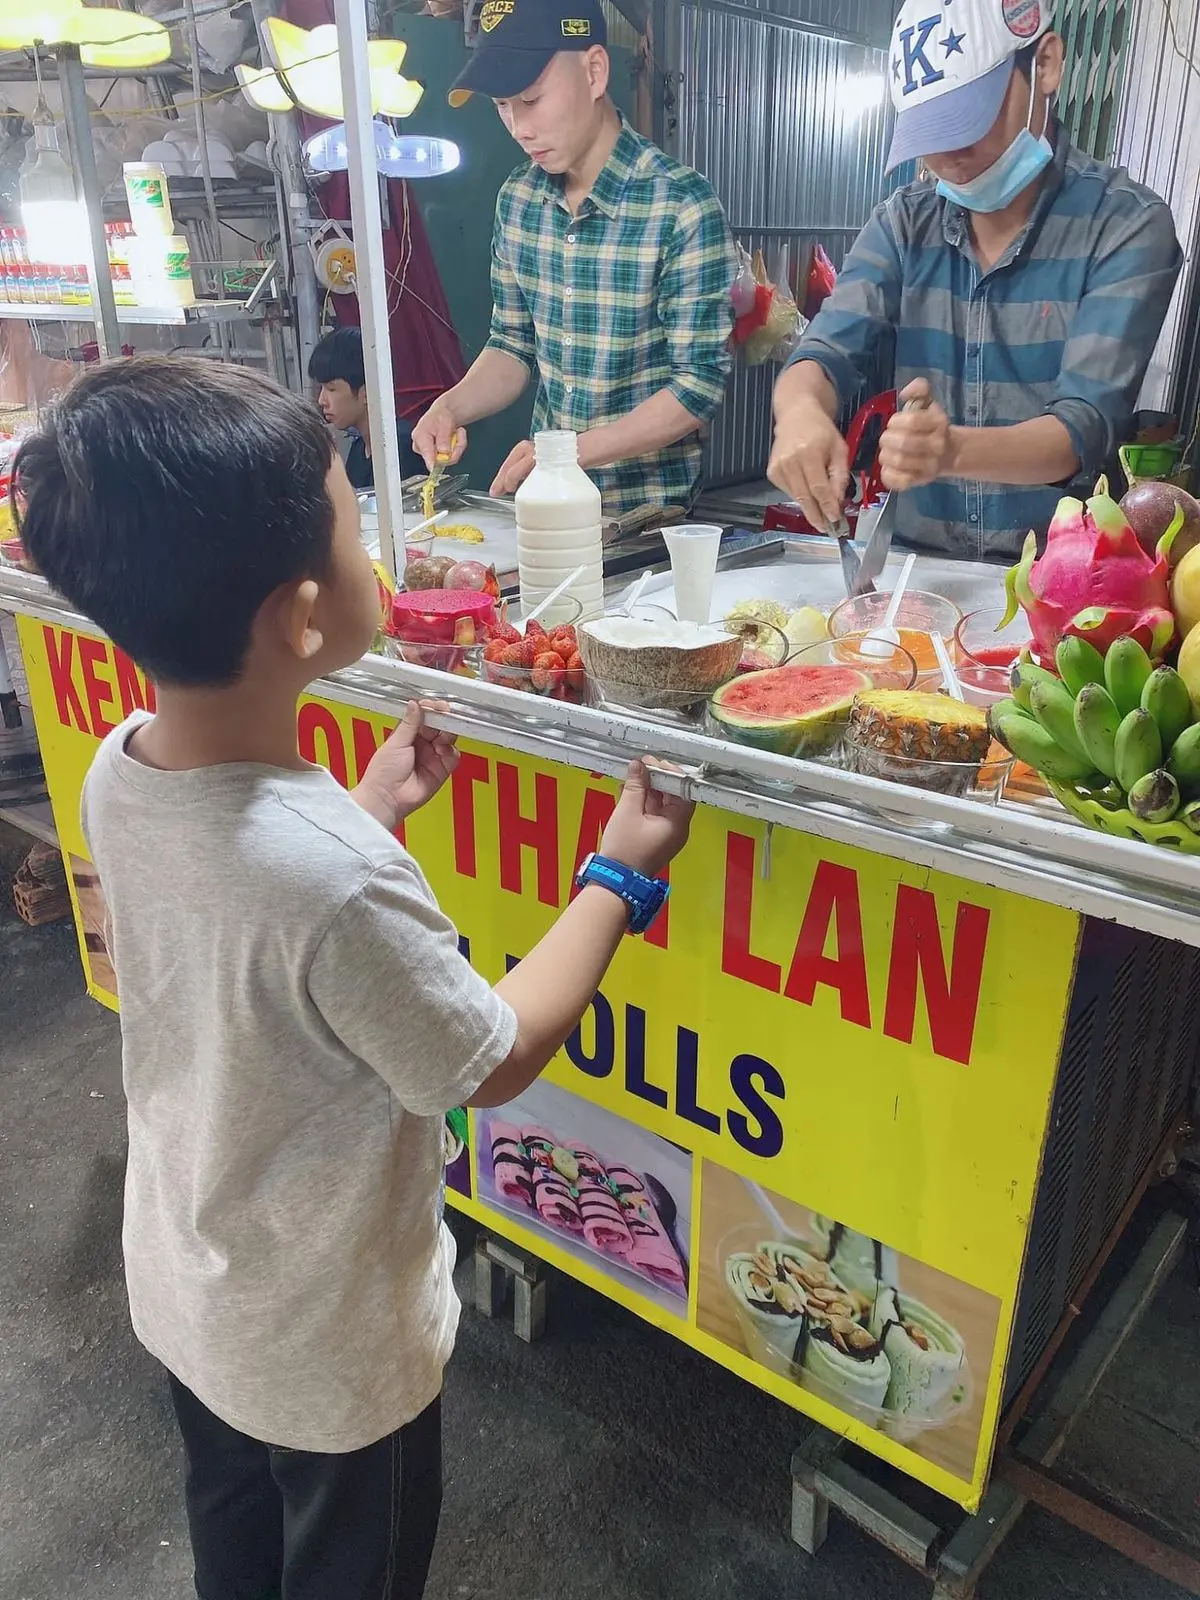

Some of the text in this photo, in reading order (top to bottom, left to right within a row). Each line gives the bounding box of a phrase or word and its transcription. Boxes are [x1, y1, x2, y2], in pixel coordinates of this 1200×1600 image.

[900, 13, 944, 96] K
[450, 751, 669, 949] TH
[722, 831, 990, 1066] LAN
[506, 953, 786, 1159] OLLS
